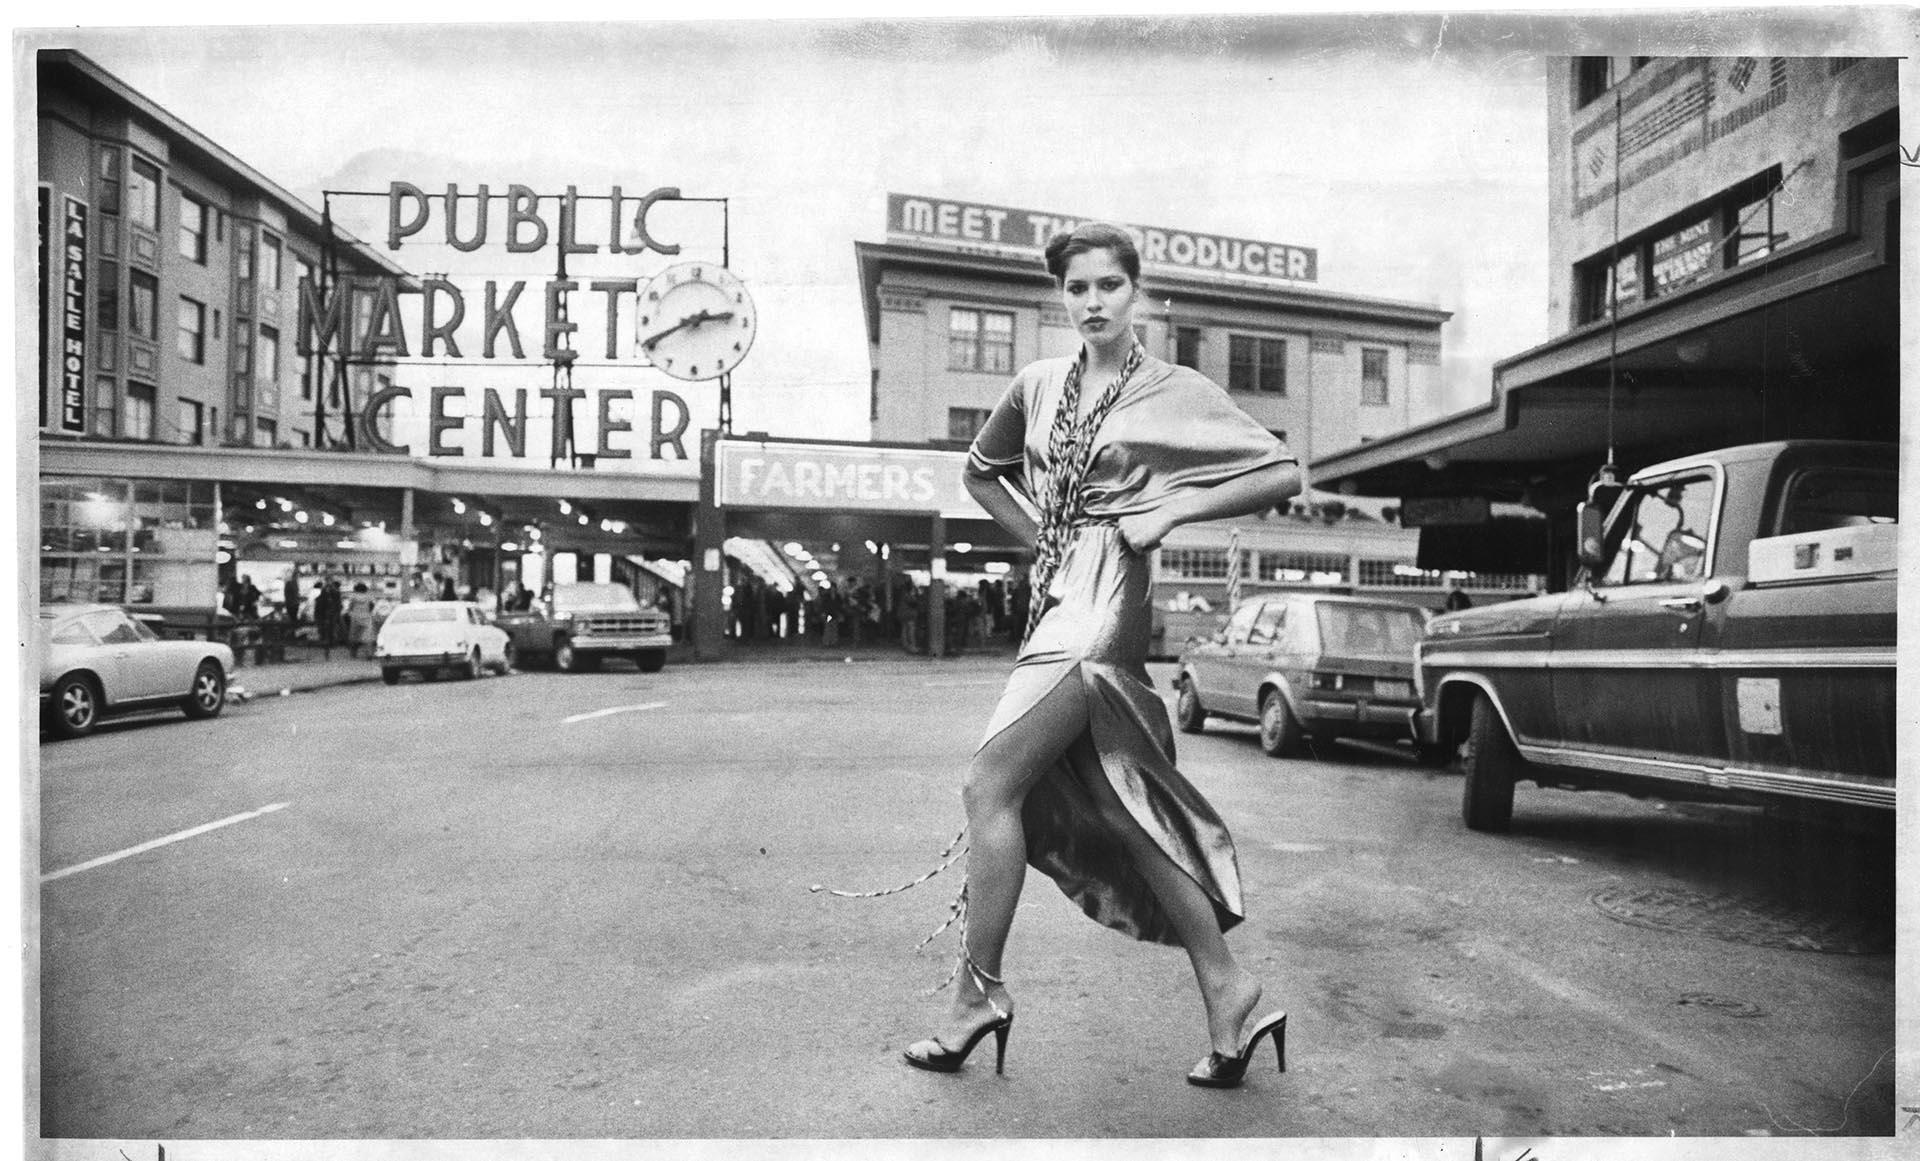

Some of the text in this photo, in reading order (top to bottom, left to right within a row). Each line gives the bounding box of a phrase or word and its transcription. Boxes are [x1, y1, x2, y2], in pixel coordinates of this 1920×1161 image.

[386, 181, 681, 255] PUBLIC
[903, 199, 1008, 241] MEET
[65, 201, 84, 425] LA SALLE HOTEL
[297, 276, 637, 359] MARKET
[360, 386, 691, 460] CENTER
[739, 457, 936, 502] FARMERS
